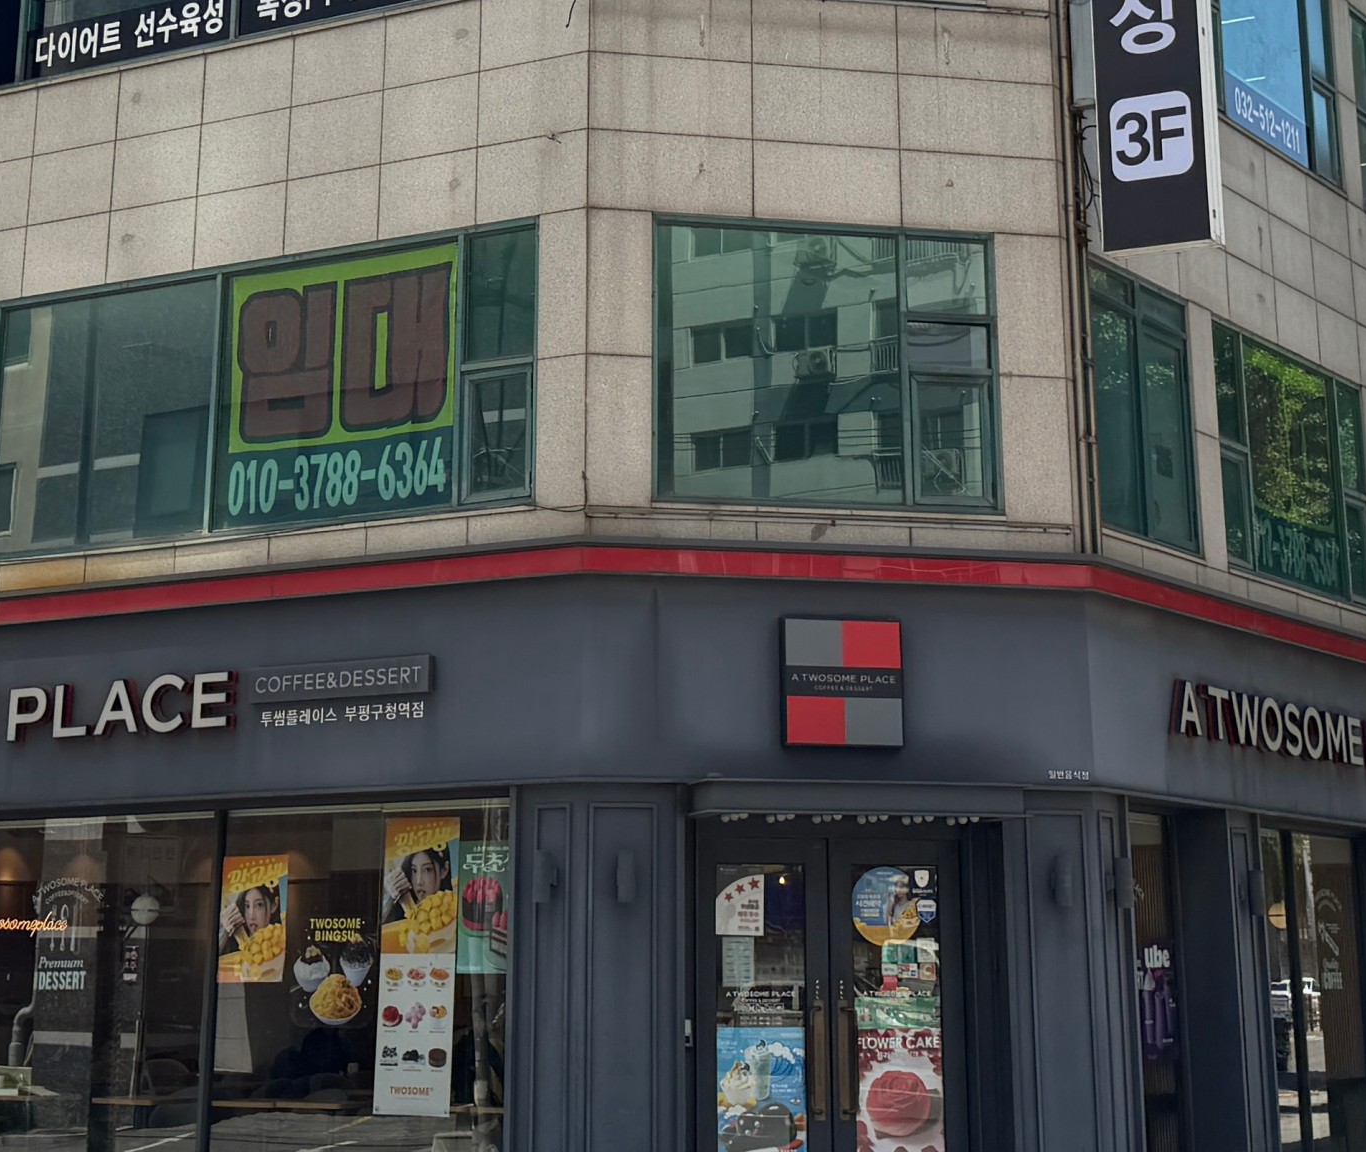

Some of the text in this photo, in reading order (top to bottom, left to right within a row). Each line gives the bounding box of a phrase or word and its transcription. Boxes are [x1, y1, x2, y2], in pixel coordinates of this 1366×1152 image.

[35, 20, 121, 68] 다이어트
[1234, 87, 1301, 154] 032-512-1211
[1116, 105, 1186, 167] 3F
[237, 261, 453, 443] 임대
[228, 436, 446, 516] 010-3788-6364
[255, 666, 421, 694] COFFEE&DESSERT
[791, 673, 897, 684] A TWOSOME PLACE
[6, 670, 237, 743] PLACE
[260, 701, 425, 728] 투썸플레이스 부평구청역점
[1180, 681, 1203, 736] A
[1208, 686, 1364, 766] TWOSOME
[1048, 769, 1090, 780] 일반음식점
[80, 878, 105, 903] PLACE
[310, 918, 361, 929] TWOSOME
[315, 931, 357, 942] BINGSU
[38, 956, 84, 969] Premium
[38, 970, 86, 990] DESSERT
[857, 1035, 940, 1049] FLOWER CAKE
[389, 1086, 430, 1097] TWOSOME
